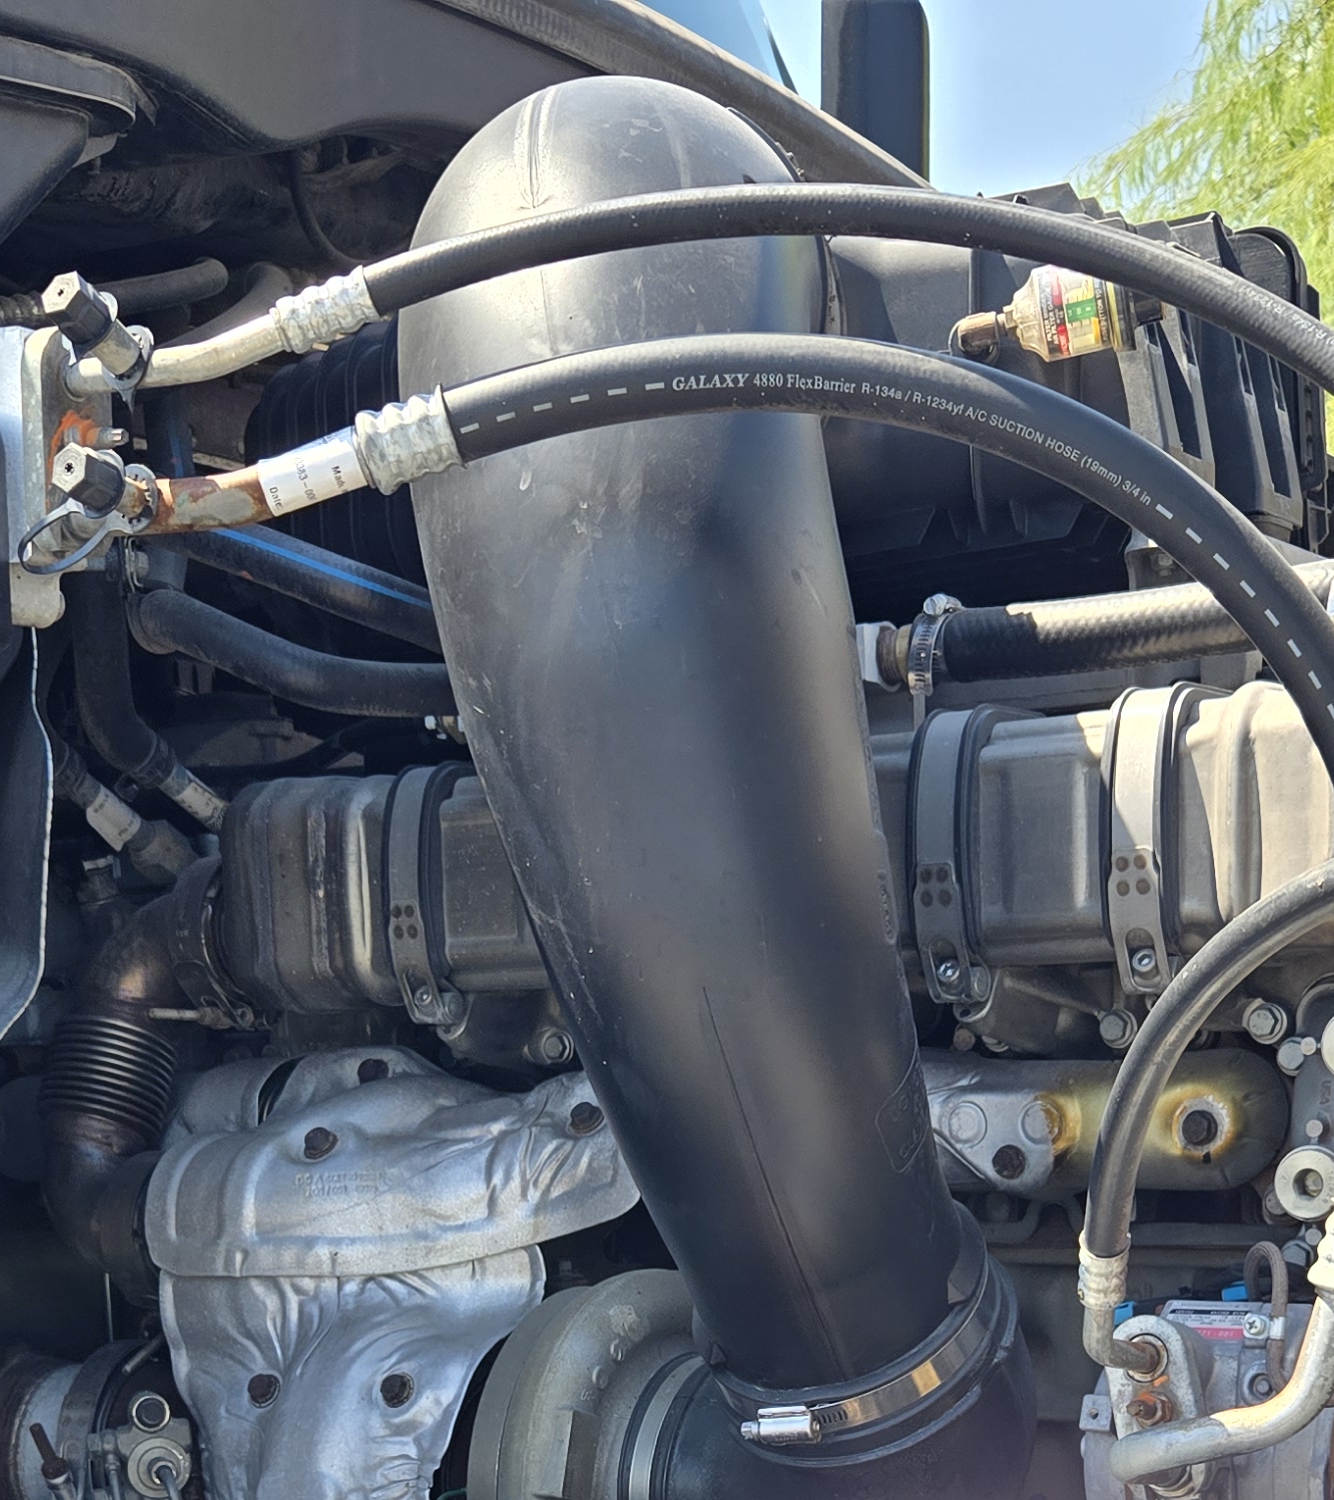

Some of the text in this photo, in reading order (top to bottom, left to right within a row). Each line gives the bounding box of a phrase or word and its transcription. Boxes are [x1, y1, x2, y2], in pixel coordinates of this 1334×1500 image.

[672, 373, 1153, 506] GALAXY 4880 FlexBarrier R-134a / R-1234yf A/C SUCTION HOSE (19mm) 3/4 in
